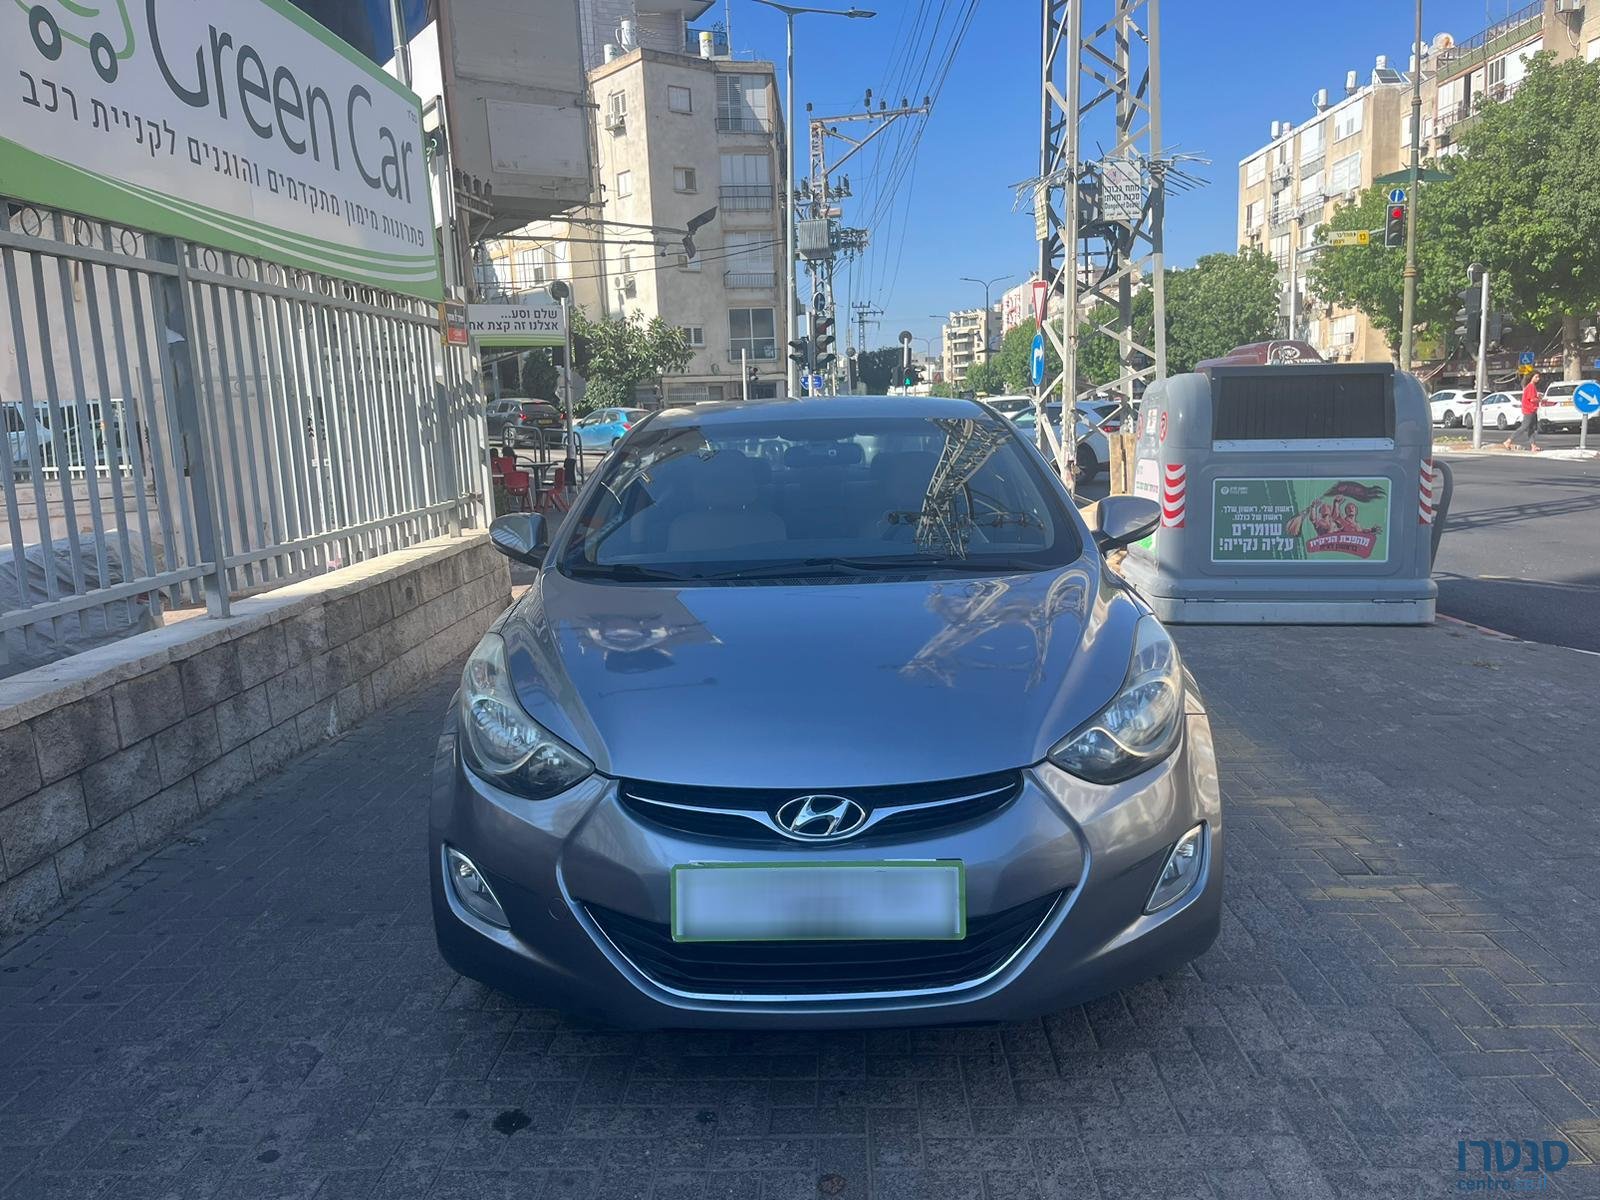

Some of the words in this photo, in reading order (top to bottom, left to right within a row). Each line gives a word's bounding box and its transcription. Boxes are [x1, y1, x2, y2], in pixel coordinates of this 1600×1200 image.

[20, 70, 78, 121] רכב
[145, 0, 340, 171] Green
[347, 84, 412, 203] Car
[91, 98, 175, 157] לקניית
[187, 136, 260, 187] והוגנים
[267, 168, 340, 216] מתקדמים
[345, 200, 378, 230] מימון
[383, 215, 424, 247] פתרונות
[501, 309, 531, 319] וסע...
[533, 308, 558, 319] שלם
[487, 321, 510, 333] קצת
[514, 321, 526, 330] זה
[529, 320, 559, 331] אצלנו
[1231, 523, 1282, 536] שומרים
[1219, 537, 1258, 553] נקייה!
[1261, 536, 1294, 552] עליה
